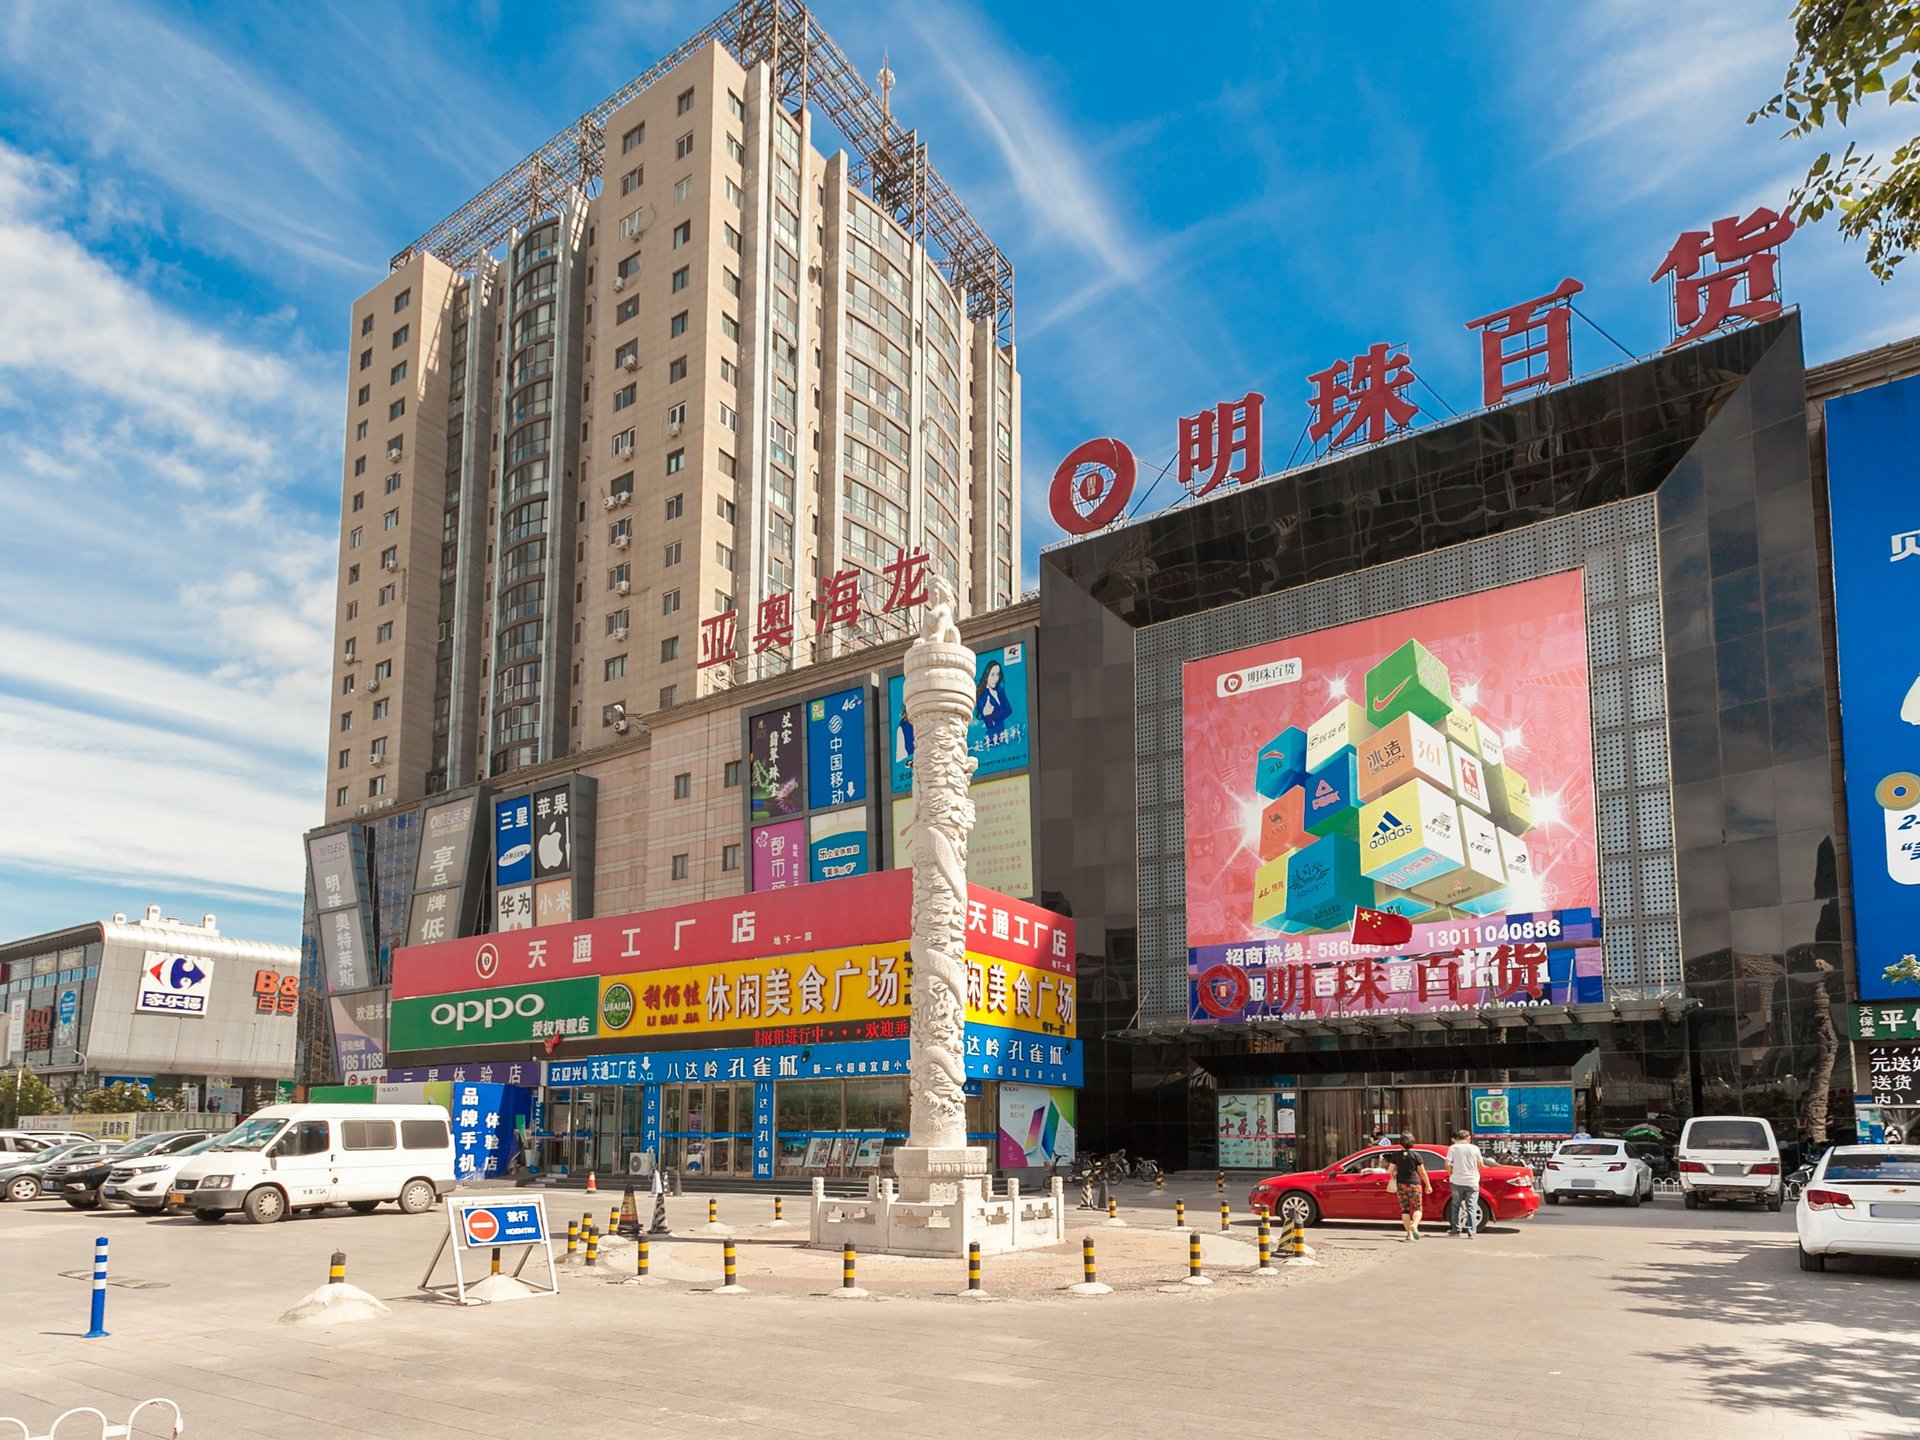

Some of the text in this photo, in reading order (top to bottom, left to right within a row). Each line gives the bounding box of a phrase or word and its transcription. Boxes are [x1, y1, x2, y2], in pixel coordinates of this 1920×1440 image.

[1176, 206, 1797, 498] 明珠百货
[697, 546, 930, 670] 亚奥海龙
[1246, 661, 1296, 684] 明珠百货
[830, 736, 845, 805] 中国移动
[500, 806, 529, 831] 三星
[537, 792, 569, 819] 苹果
[1369, 823, 1413, 850] adidas
[500, 892, 531, 918] 华为
[539, 889, 571, 916] 小米
[421, 893, 447, 945] 牌低
[968, 900, 1067, 959] 天通工厂店
[527, 910, 757, 970] 天通工厂店
[1425, 919, 1561, 949] 13011040886
[335, 913, 356, 988] 奥特莱斯
[704, 955, 900, 1022] 休闲美食广场
[1265, 943, 1549, 1014] 明珠百货
[145, 993, 202, 1010] 家乐福
[256, 995, 298, 1015] 百安
[642, 980, 702, 1011] 利佰佳
[24, 1005, 53, 1033] B&Q
[356, 1003, 391, 1022] 欢迎光
[660, 1013, 679, 1026] BAI
[682, 1012, 700, 1025] JIA
[1859, 1006, 1875, 1038] 天保堂
[532, 1016, 590, 1039] 授权旗舰店
[341, 1054, 359, 1071] 186
[591, 1060, 636, 1081] 天通工厂店
[1872, 1074, 1912, 1091] 送货
[459, 1086, 479, 1173] 品牌手机
[484, 1112, 500, 1172] 体验店
[757, 1083, 769, 1175] 八达岭孔雀城
